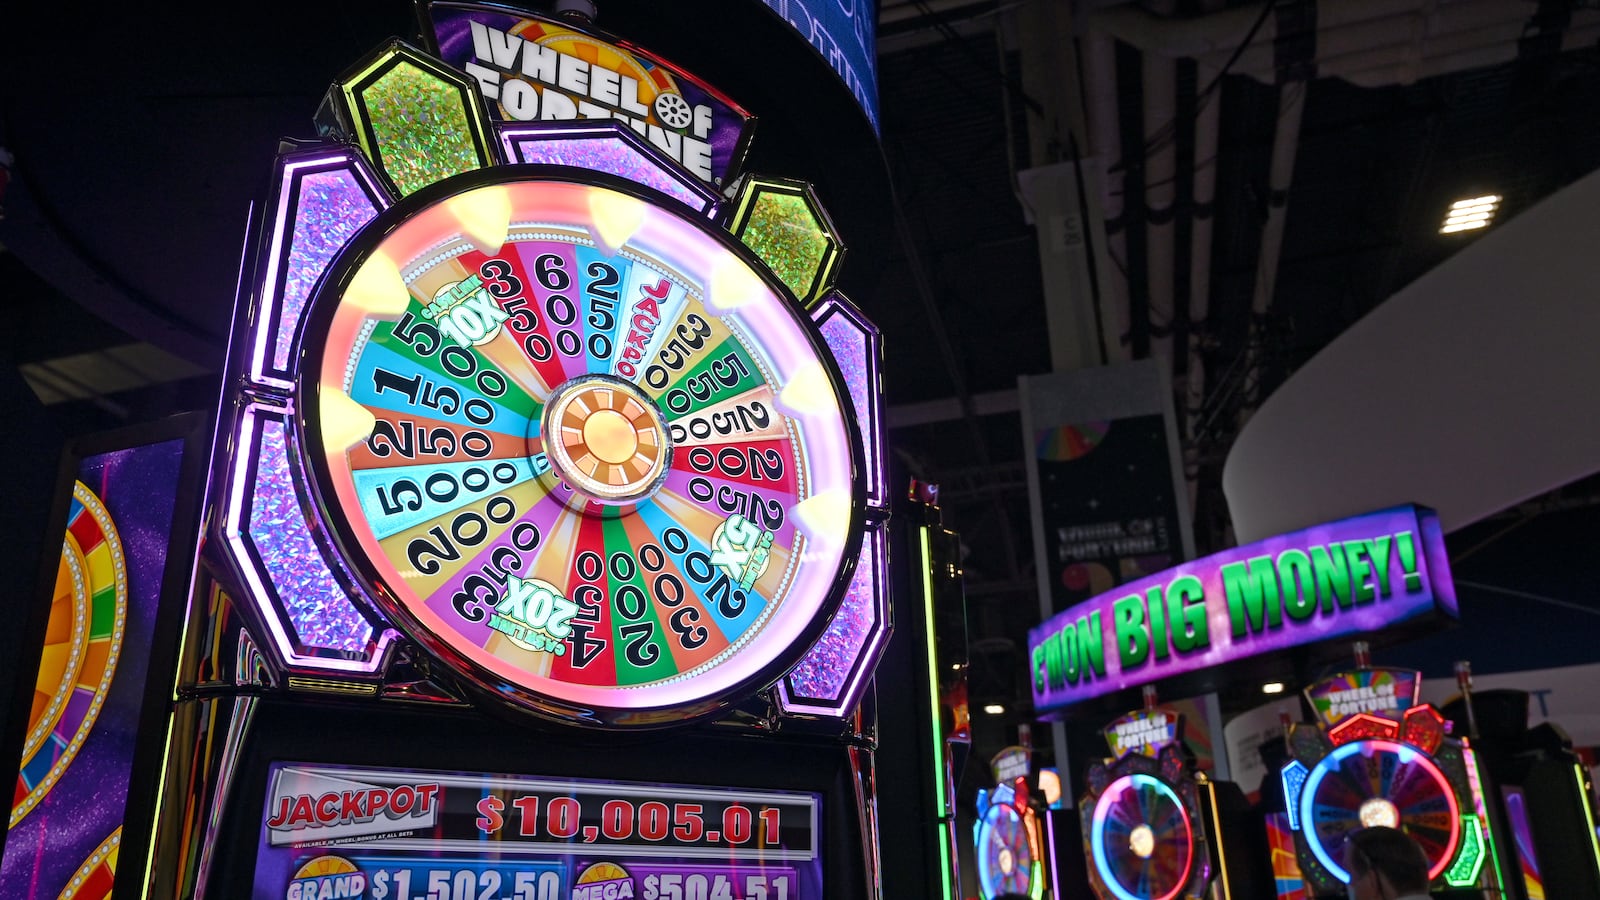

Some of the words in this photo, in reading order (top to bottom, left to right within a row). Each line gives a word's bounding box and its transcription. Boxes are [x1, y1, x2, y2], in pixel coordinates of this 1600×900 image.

[470, 20, 649, 117] WHEEL
[438, 287, 510, 350] 10X
[481, 259, 553, 362] 350
[534, 253, 582, 357] 600
[586, 262, 620, 360] 250
[393, 312, 507, 398] 500
[645, 313, 712, 390] 350
[666, 352, 750, 414] 550
[372, 367, 496, 426] 150
[367, 419, 493, 460] 250
[688, 447, 785, 482] 200
[406, 496, 517, 576] 200
[688, 477, 785, 532] 250
[451, 522, 542, 623] 350
[662, 527, 747, 619] 200
[709, 514, 763, 584] 5X
[495, 574, 579, 639] 20X
[567, 551, 606, 669] 450
[609, 552, 660, 667] 200
[638, 543, 709, 650] 300
[1032, 608, 1106, 692] C'MON
[1113, 575, 1211, 669] BIG
[1220, 531, 1422, 638] MONEY!
[1328, 686, 1376, 703] WHEEL
[1330, 696, 1398, 716] FORTUNE
[266, 782, 439, 831] JACKPOT
[476, 795, 781, 845] $10,005.01
[287, 875, 365, 900] GRAND
[572, 880, 634, 900] MEGA
[643, 873, 790, 900] $50451
